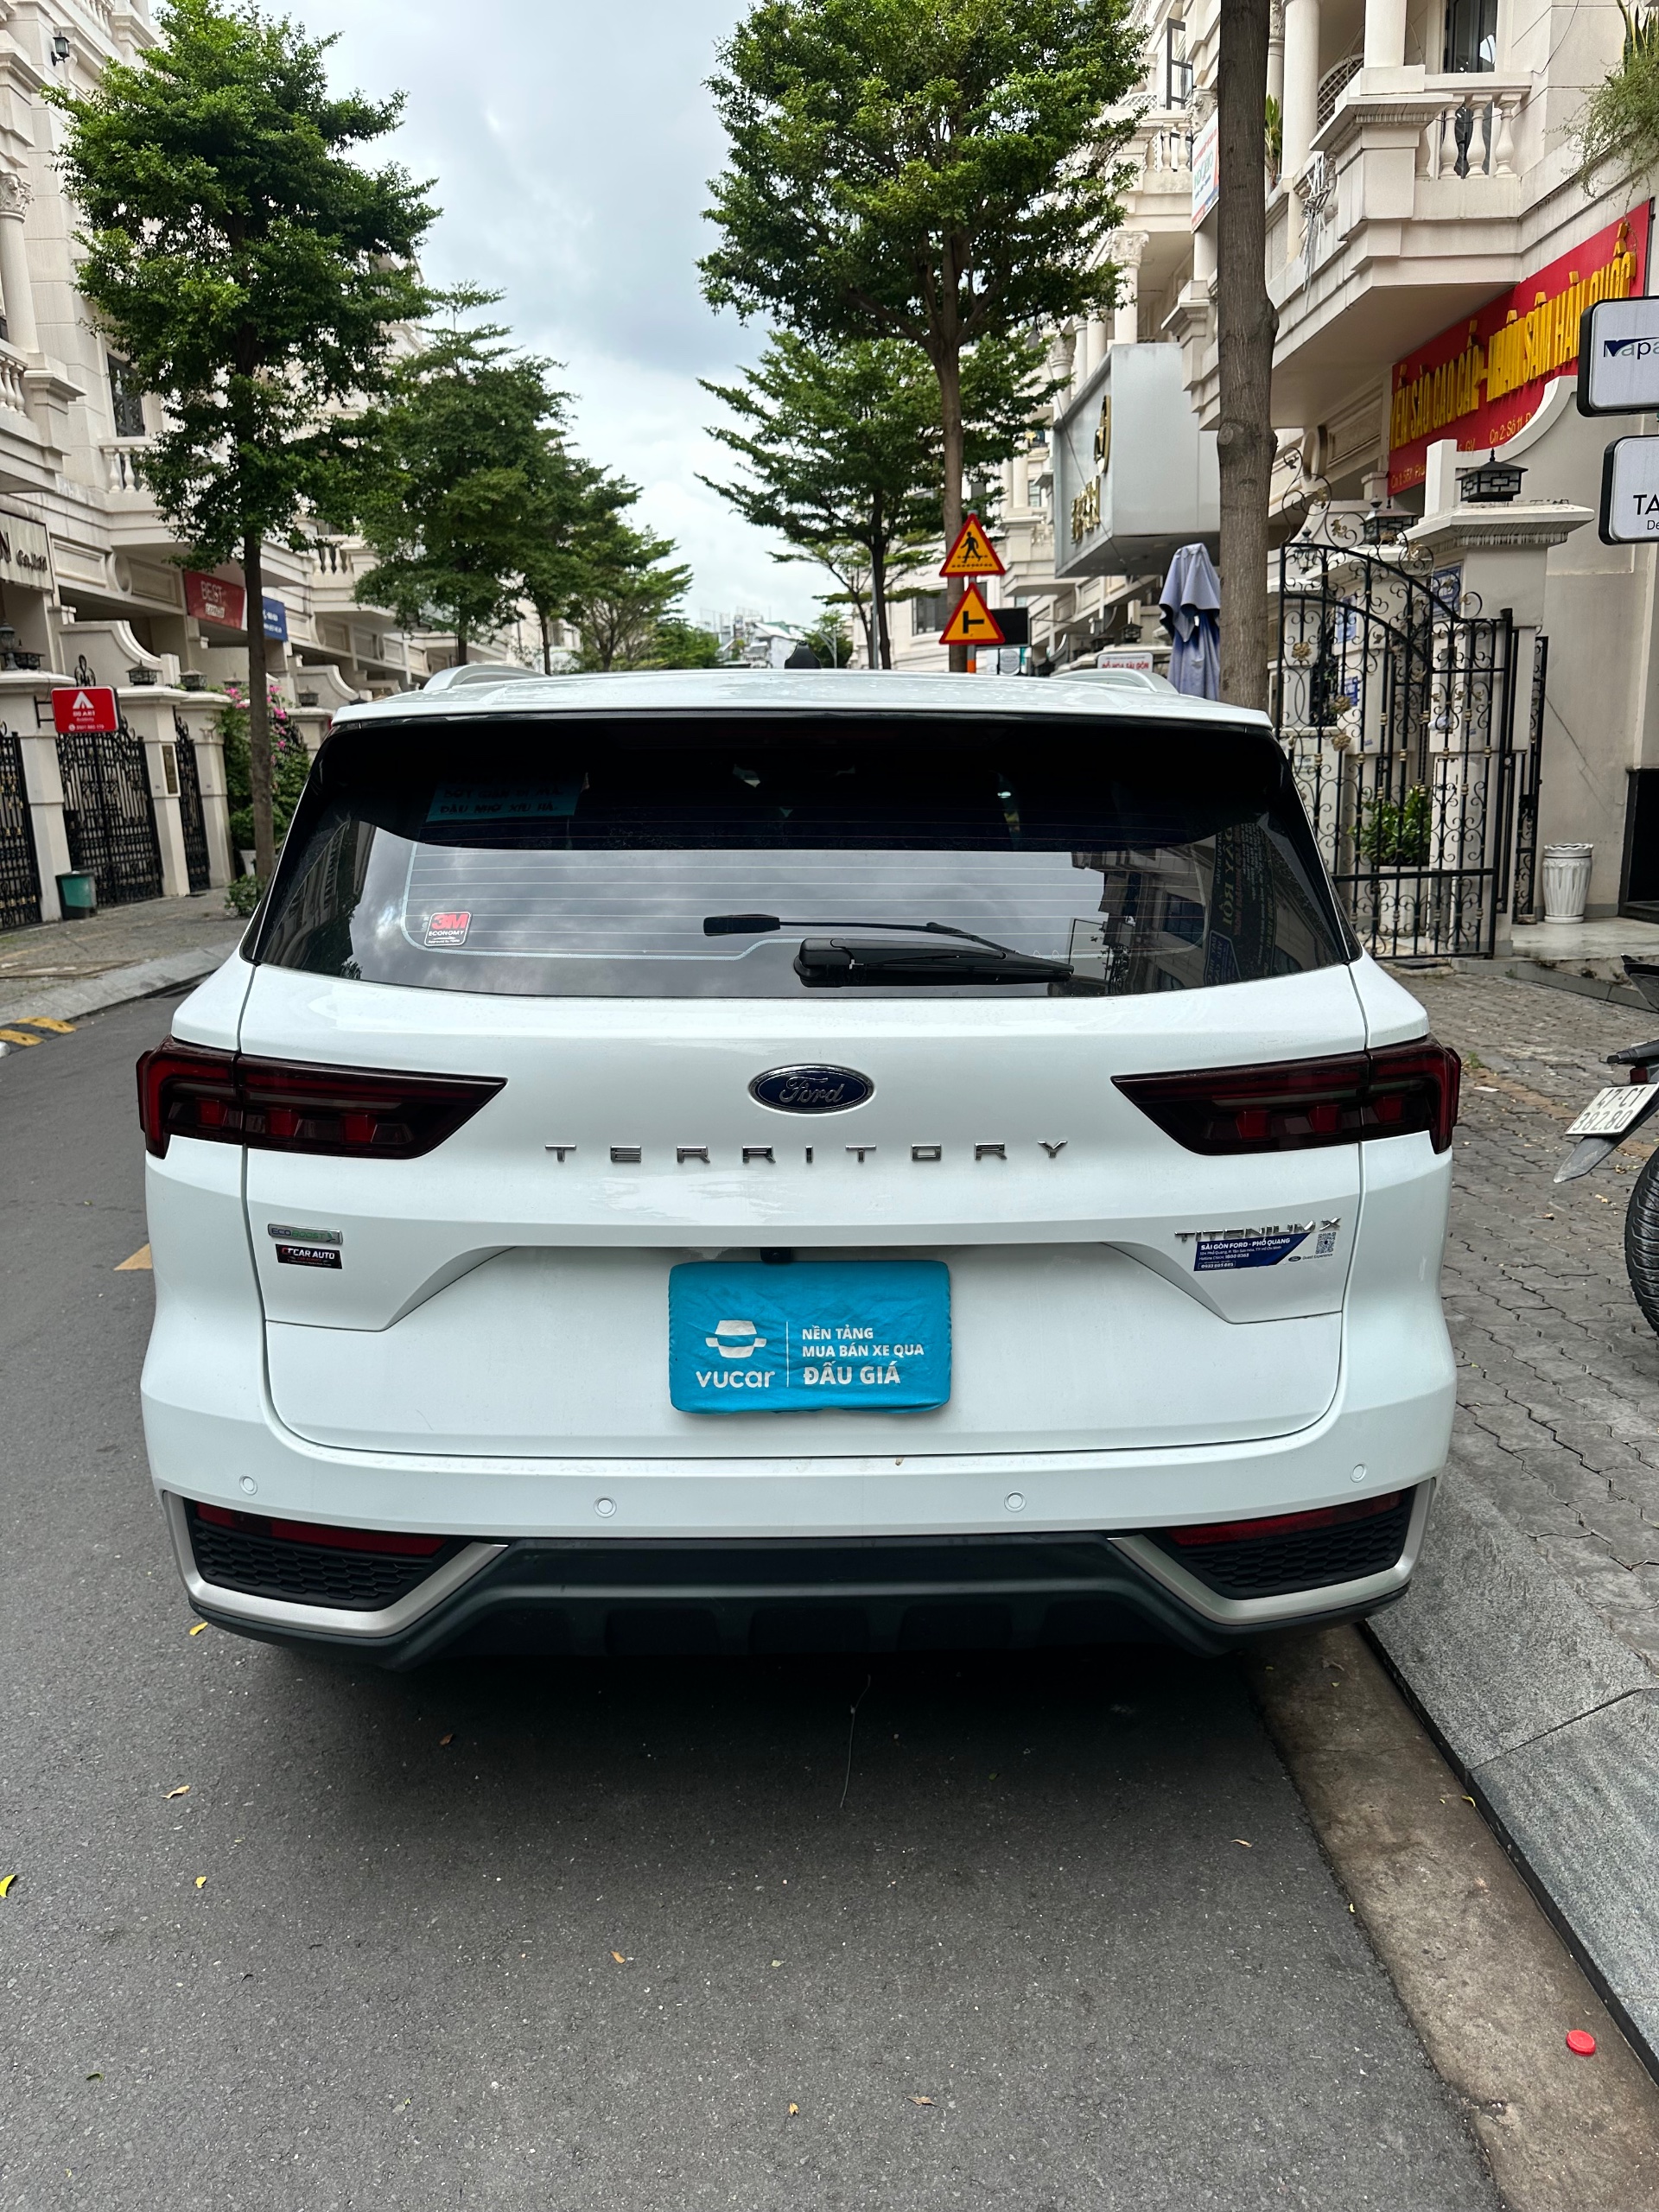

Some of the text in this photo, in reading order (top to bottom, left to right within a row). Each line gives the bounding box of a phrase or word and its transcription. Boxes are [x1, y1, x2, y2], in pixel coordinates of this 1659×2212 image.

[1411, 364, 1433, 440] SÀO
[1433, 359, 1457, 429] CAO
[1456, 320, 1484, 416] CẤP
[1523, 292, 1556, 384] SÂM
[200, 580, 223, 603] BEST
[432, 913, 468, 930] 3M
[779, 1077, 845, 1104] Ford
[545, 1140, 1068, 1163] TERRITORY
[271, 1228, 326, 1239] ECOBOOST
[1175, 1217, 1342, 1243] TITANIUM X
[1201, 1242, 1213, 1250] SÀI
[1213, 1241, 1229, 1249] GÒN
[1229, 1240, 1247, 1249] FORD
[1267, 1237, 1291, 1247] QUANG
[802, 1324, 874, 1340] NỀN TẢNG
[802, 1342, 925, 1357] MUA BÁN XE QUA
[696, 1370, 776, 1389] vucar
[803, 1361, 900, 1385] ĐẤU GIÁ
